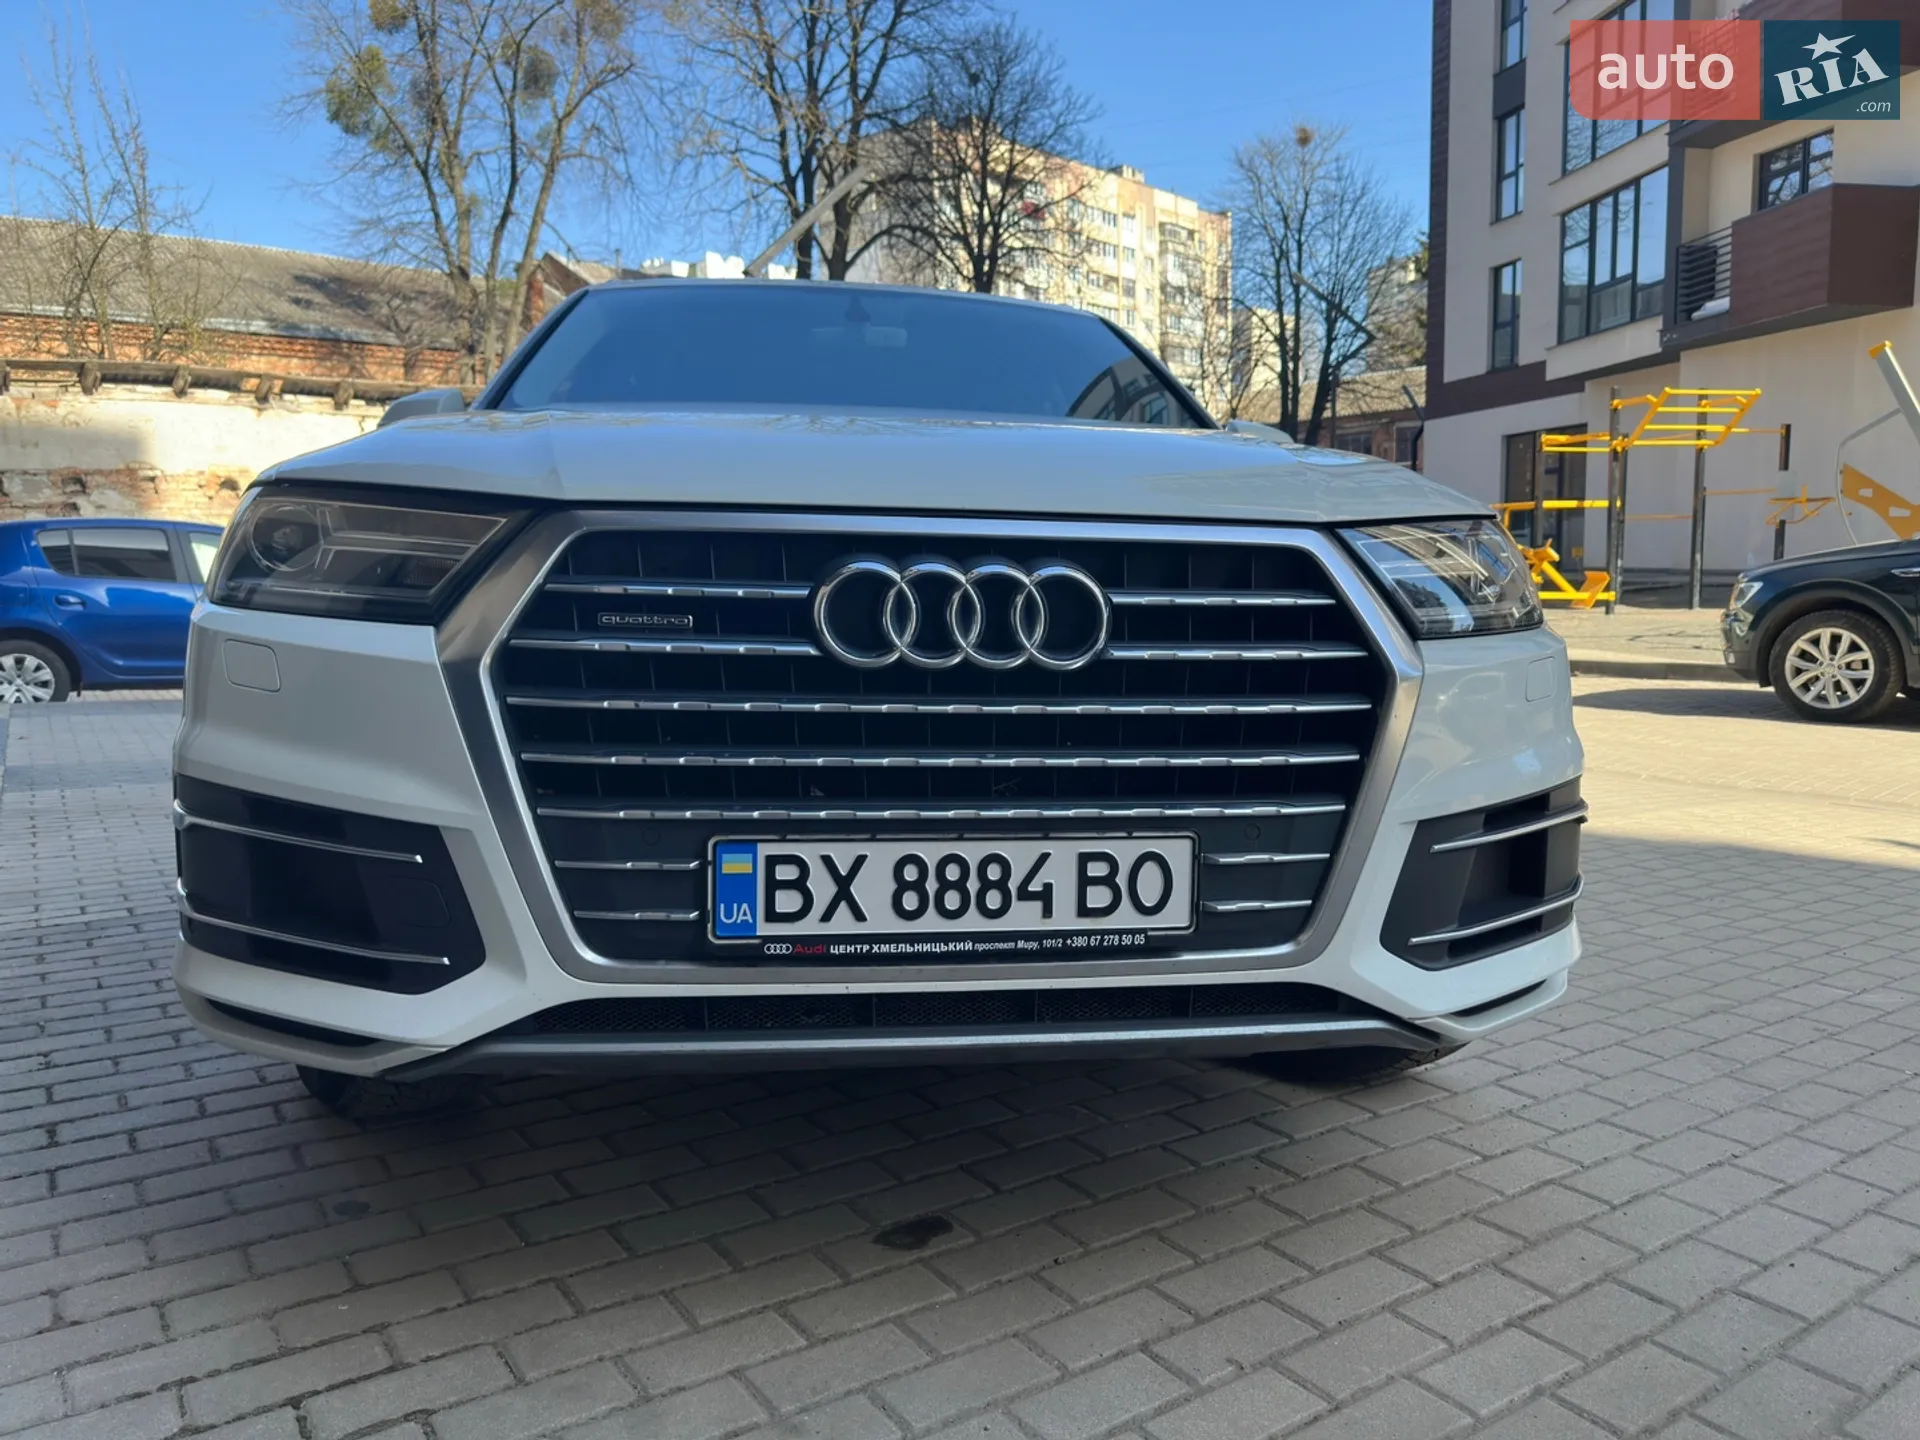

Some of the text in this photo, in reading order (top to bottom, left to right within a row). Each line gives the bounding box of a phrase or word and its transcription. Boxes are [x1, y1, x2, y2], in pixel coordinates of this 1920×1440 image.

[602, 615, 688, 625] quattro
[764, 850, 1174, 923] BX 8884 BO
[720, 904, 753, 924] UA
[793, 933, 1146, 954] Audi ЦЕНТР ХМЕЛЬНИЦЬКИЙ проспект Миру, 101/2 +380 67 278 50 05
